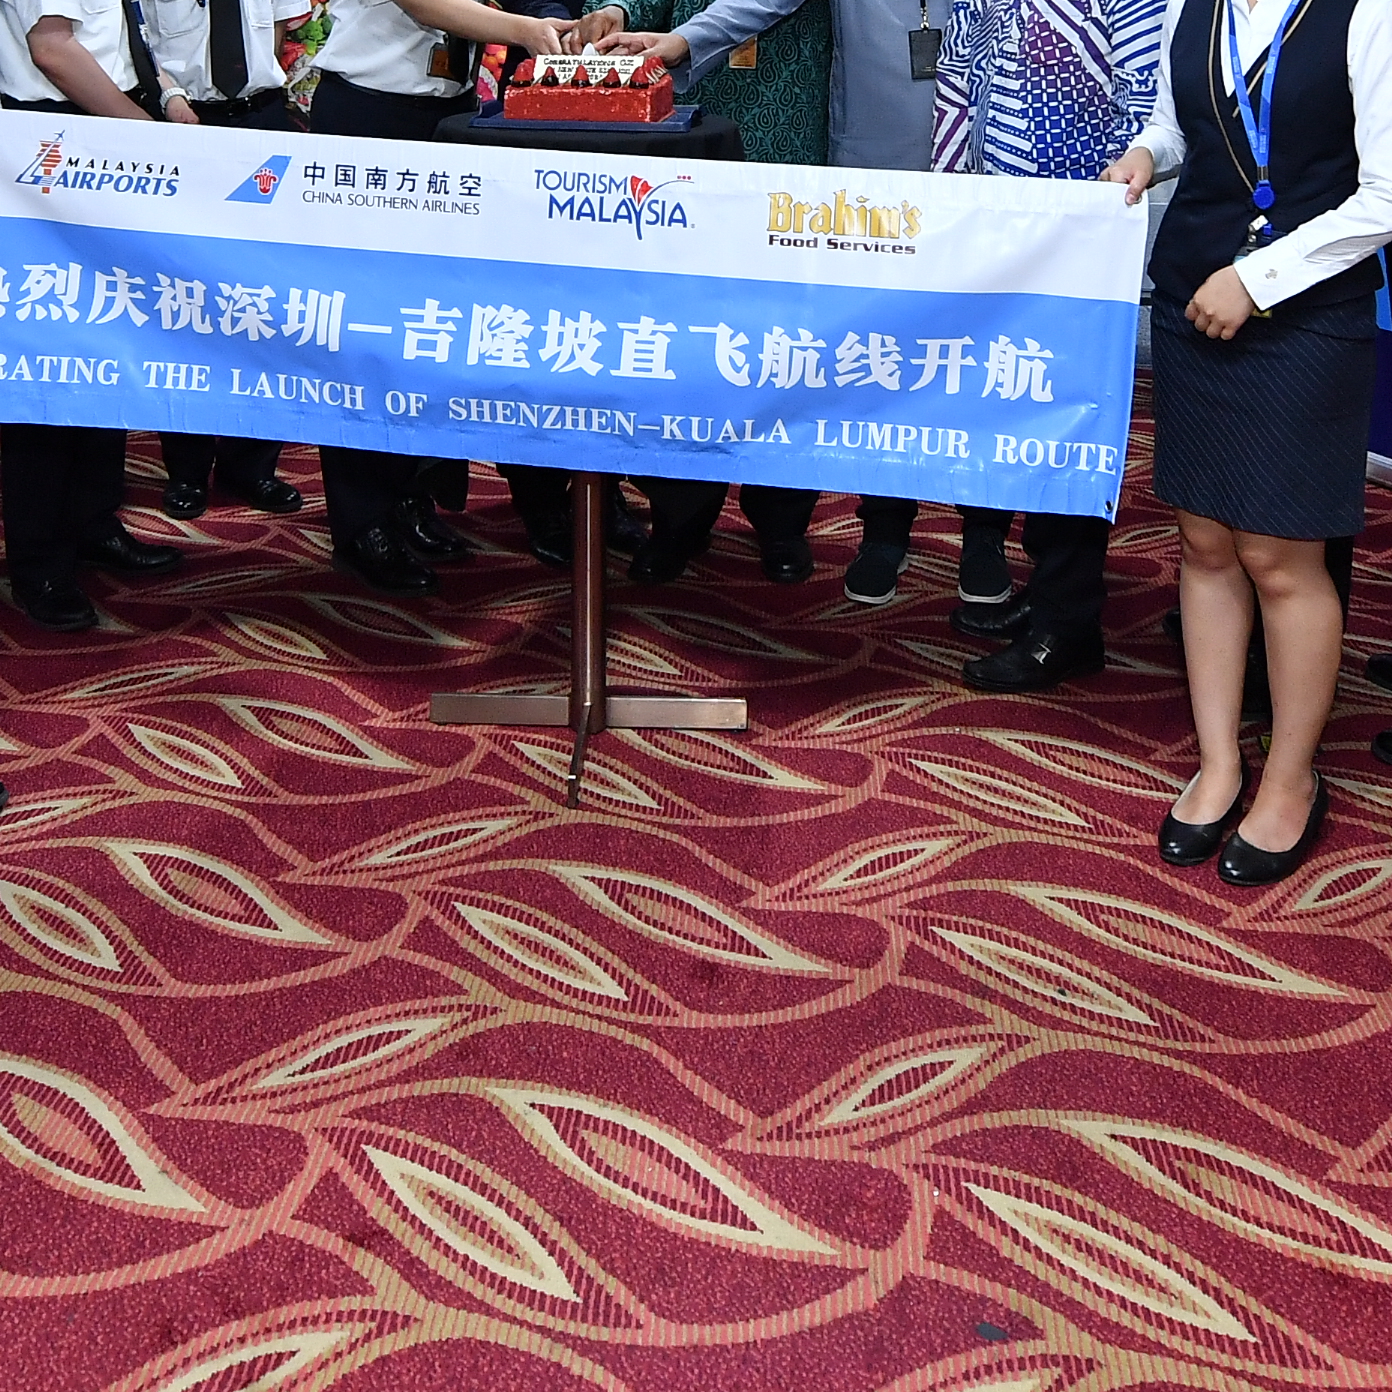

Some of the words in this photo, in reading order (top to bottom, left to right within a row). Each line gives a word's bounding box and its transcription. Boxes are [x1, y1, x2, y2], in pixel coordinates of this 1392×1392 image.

[66, 157, 180, 176] MALAYSIA
[303, 161, 483, 198] 中国南方航空
[54, 170, 180, 196] AIRPORTS
[534, 169, 628, 196] TOURISM
[302, 190, 343, 205] CHINA
[346, 195, 418, 211] SOUTHERN
[422, 200, 480, 216] AIRLINES
[766, 189, 922, 239] Brahim's
[548, 194, 688, 240] MALAYSIA
[768, 234, 819, 249] Food
[826, 239, 916, 255] Services
[142, 361, 211, 392] THE
[230, 369, 365, 410] LAUNCH
[385, 391, 428, 418] OF
[814, 419, 971, 459] LUMPUR
[993, 434, 1120, 476] ROUTE
